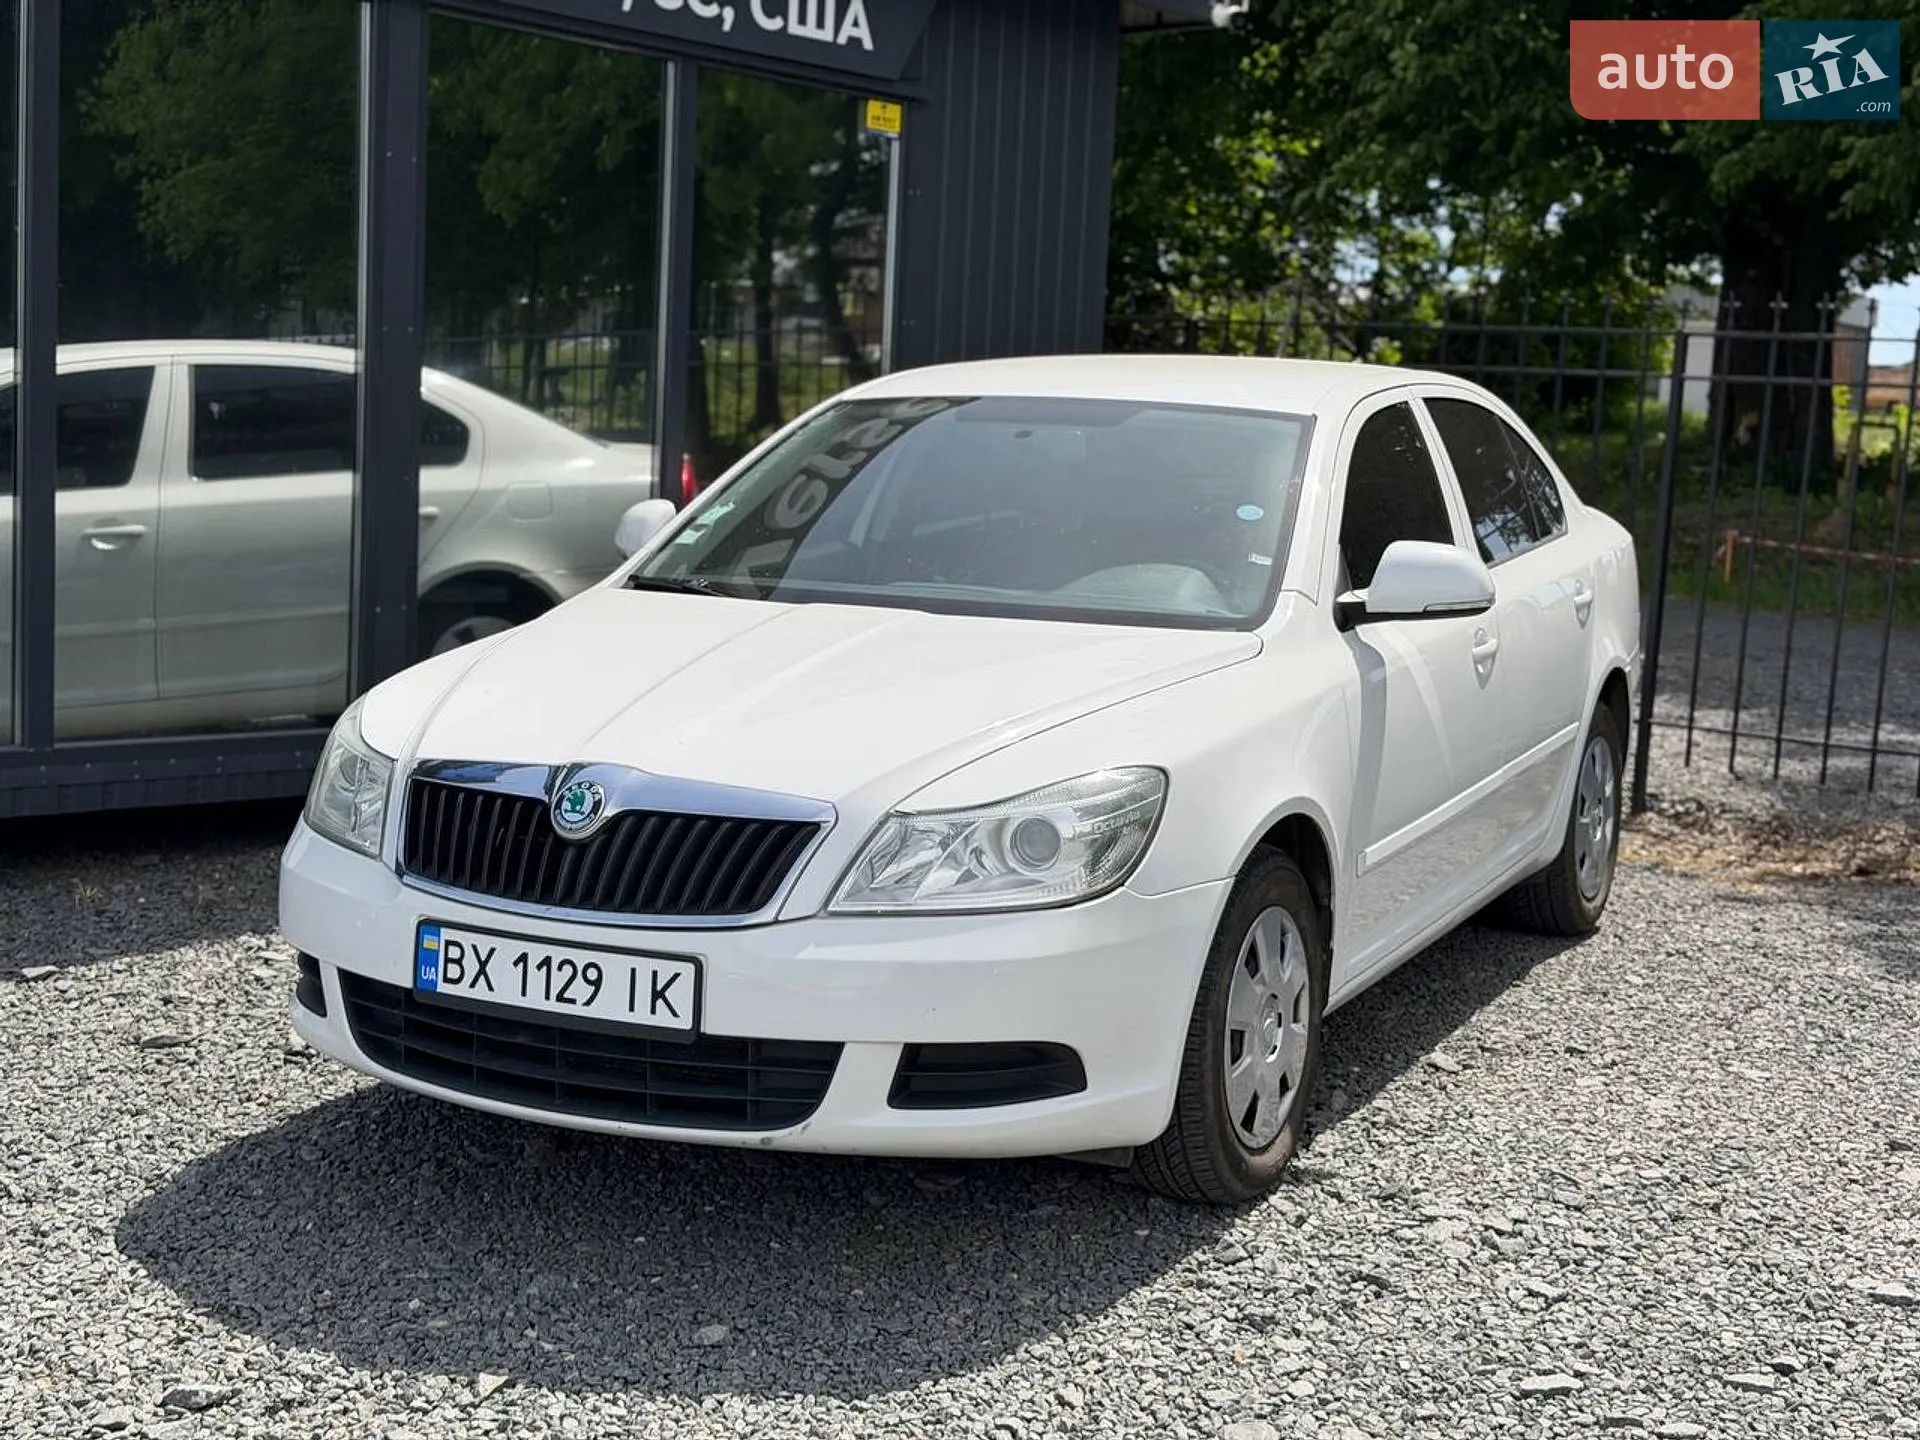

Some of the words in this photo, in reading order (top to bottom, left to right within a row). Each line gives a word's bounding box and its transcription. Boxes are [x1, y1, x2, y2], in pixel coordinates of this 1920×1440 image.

[421, 965, 437, 982] UA
[443, 939, 497, 993] BX
[512, 951, 604, 1007] 1129
[629, 967, 682, 1018] IK
